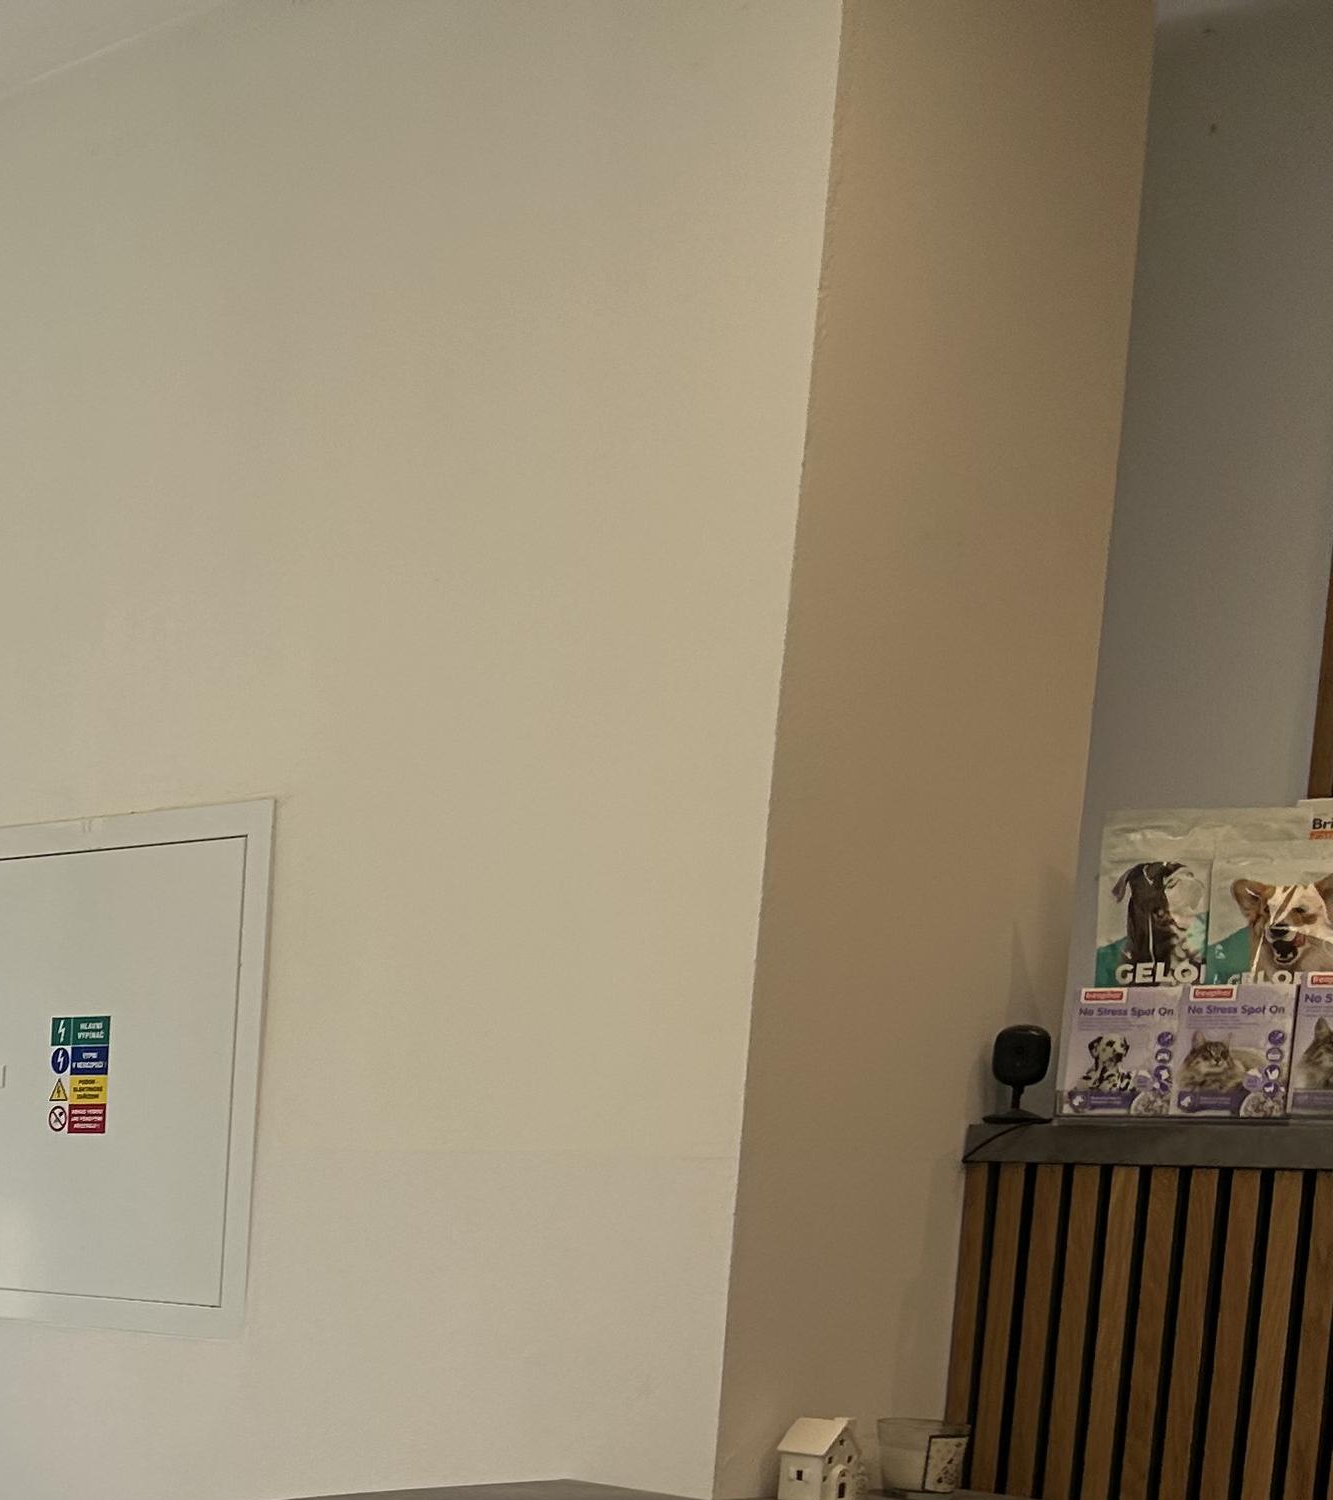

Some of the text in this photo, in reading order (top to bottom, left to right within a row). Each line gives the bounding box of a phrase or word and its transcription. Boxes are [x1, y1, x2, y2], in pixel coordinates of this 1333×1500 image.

[1115, 962, 1206, 985] GELO
[1304, 994, 1320, 1003] No
[1079, 1006, 1175, 1018] No Stress Spot On
[1187, 1004, 1286, 1016] No Stress Spot On
